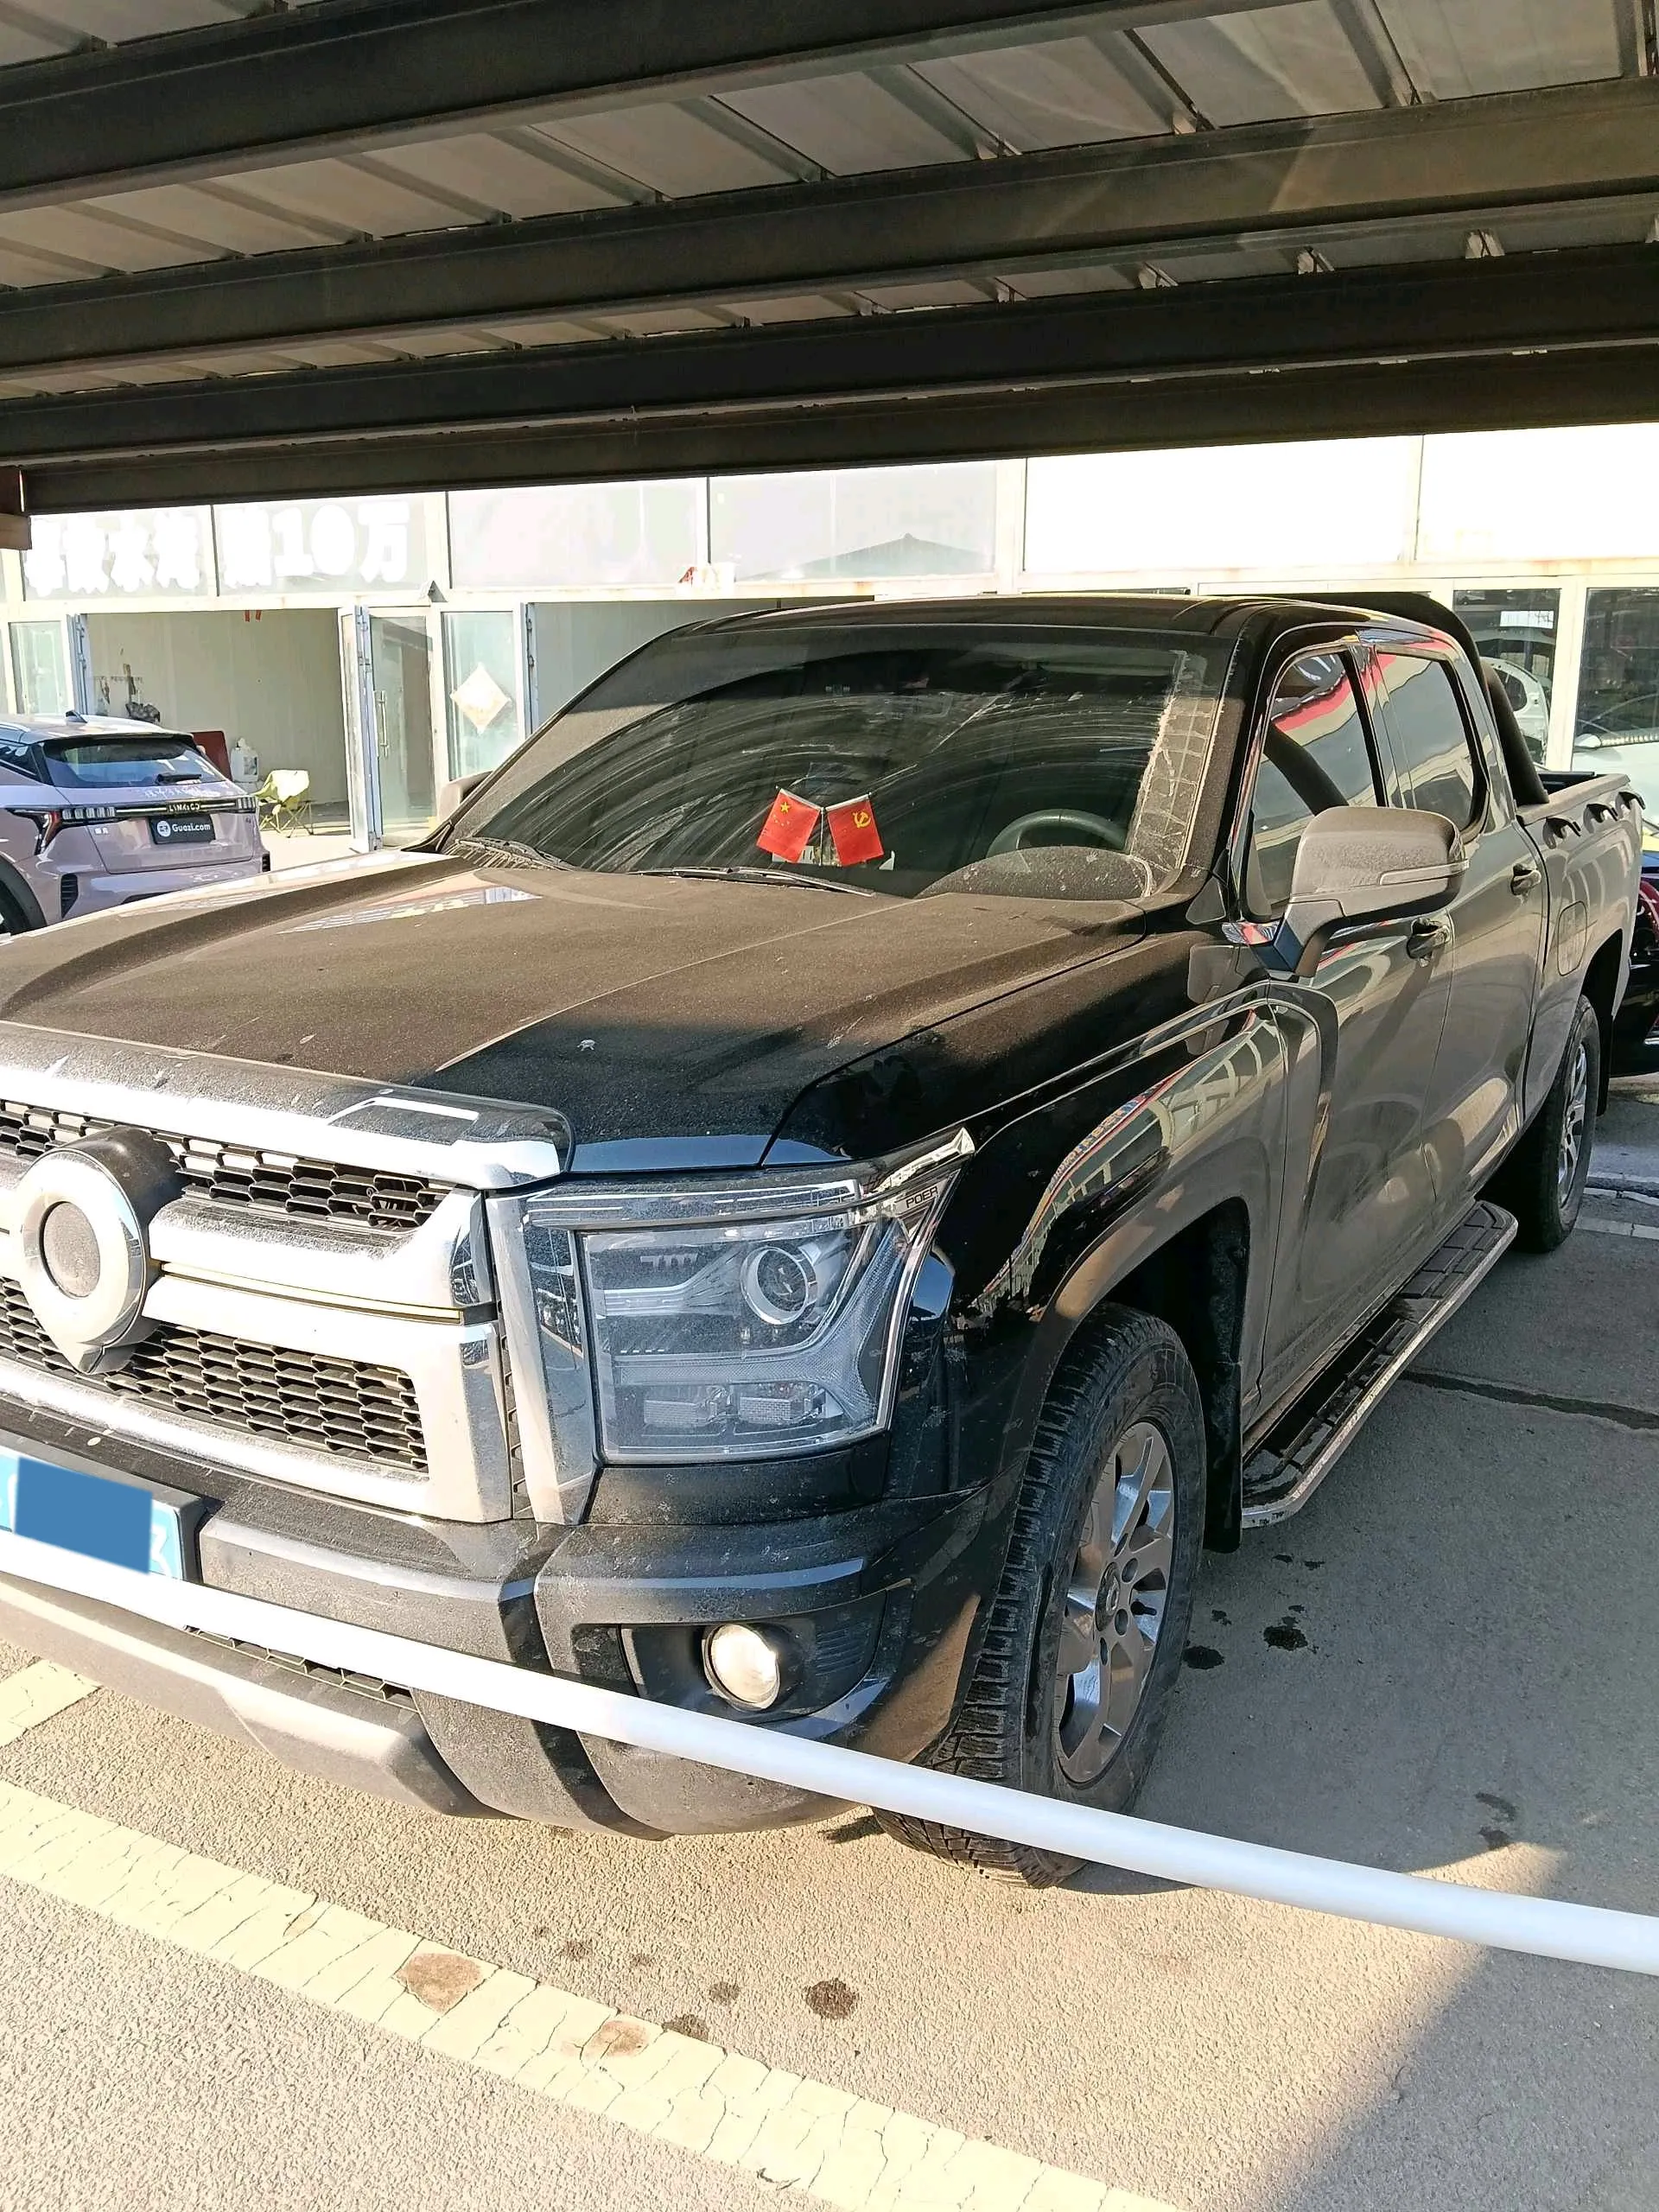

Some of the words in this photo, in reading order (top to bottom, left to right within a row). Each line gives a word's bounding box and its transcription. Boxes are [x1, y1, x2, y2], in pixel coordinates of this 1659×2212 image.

[221, 499, 410, 588] 10万
[172, 823, 211, 832] Guazi.com
[906, 1185, 938, 1209] POER
